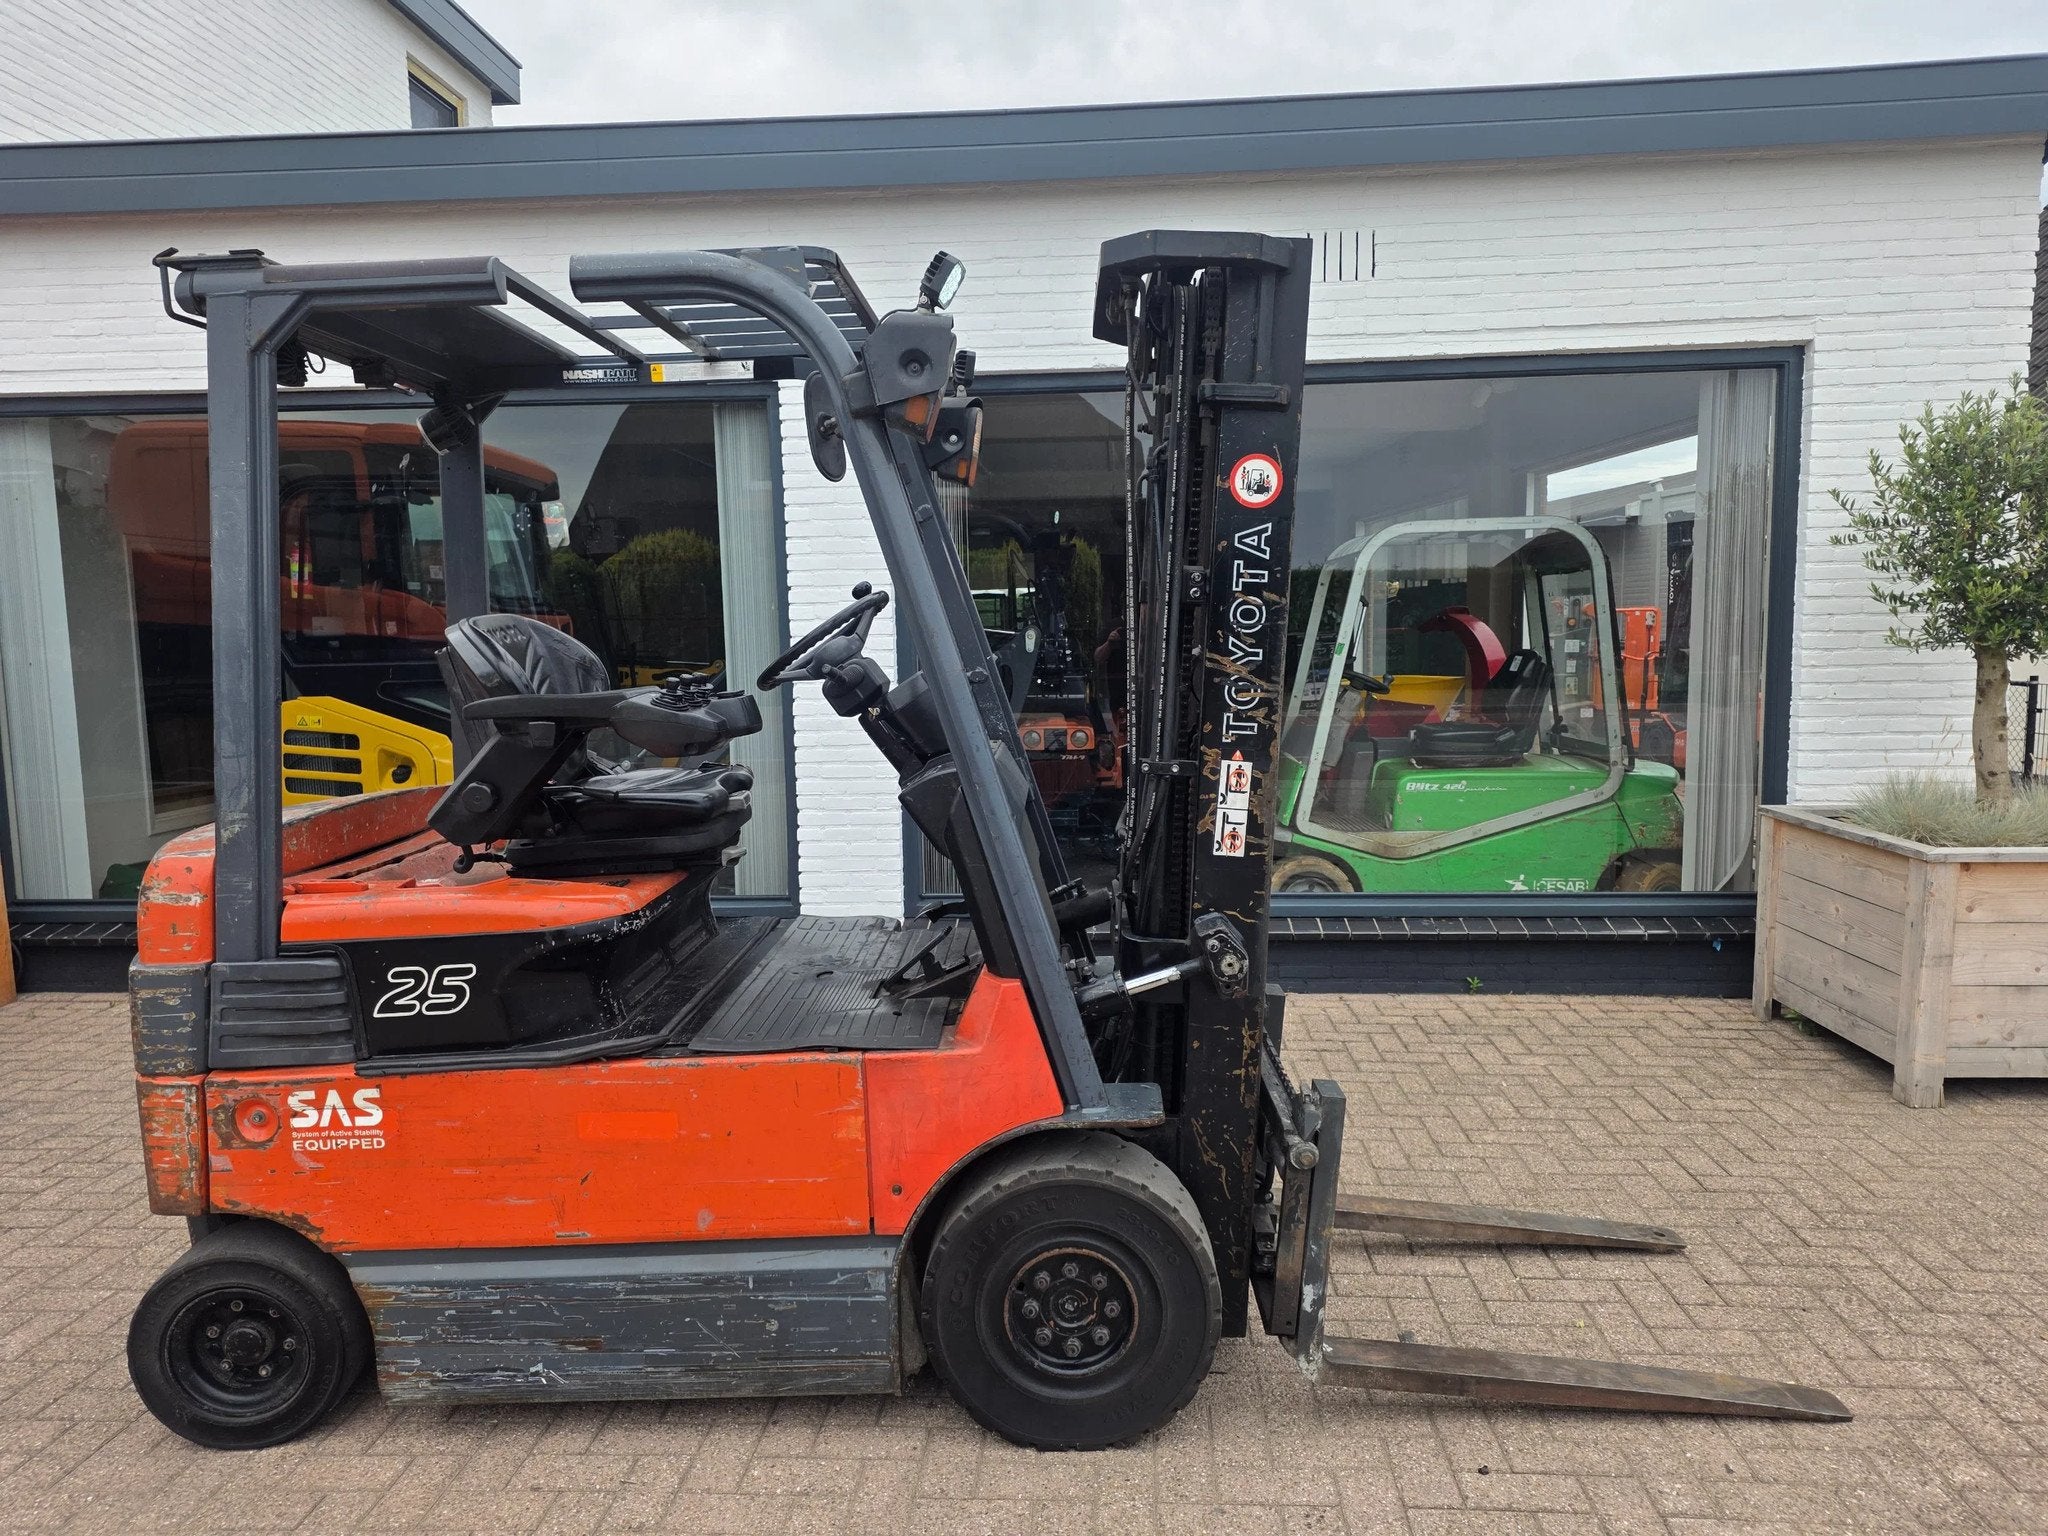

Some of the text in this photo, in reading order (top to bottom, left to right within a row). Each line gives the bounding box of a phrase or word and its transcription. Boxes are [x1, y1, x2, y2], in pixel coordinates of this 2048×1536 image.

[562, 368, 637, 380] NASHBAIT
[1222, 522, 1272, 743] TOYOTA
[1405, 782, 1439, 791] Blitz
[1535, 880, 1586, 892] CESAB
[373, 963, 477, 1018] 25
[287, 1088, 384, 1128] SAS
[292, 1130, 320, 1139] System
[330, 1129, 353, 1137] Active
[353, 1129, 384, 1137] Stability
[292, 1137, 386, 1151] EQUIPPED
